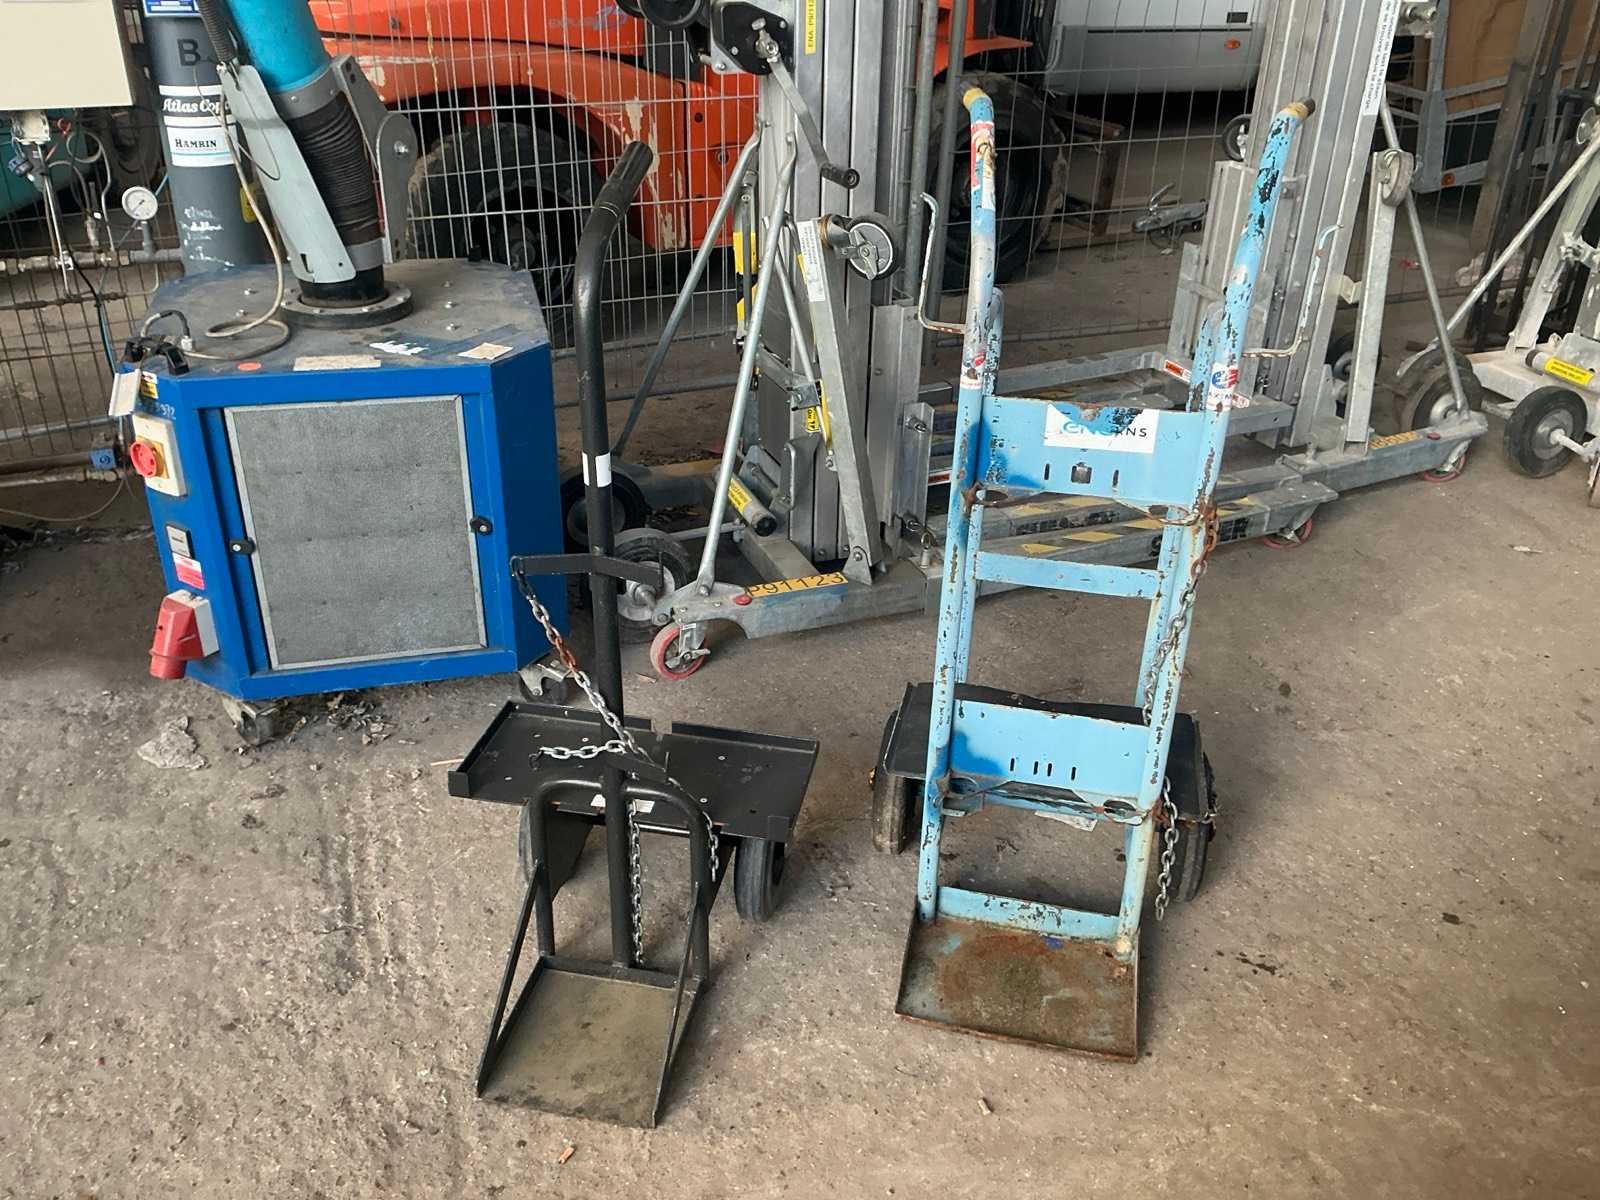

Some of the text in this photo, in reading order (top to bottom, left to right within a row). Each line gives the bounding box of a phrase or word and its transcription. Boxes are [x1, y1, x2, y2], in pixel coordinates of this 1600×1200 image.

[177, 39, 200, 66] B
[163, 98, 199, 113] Atlas
[744, 572, 845, 598] P91123
